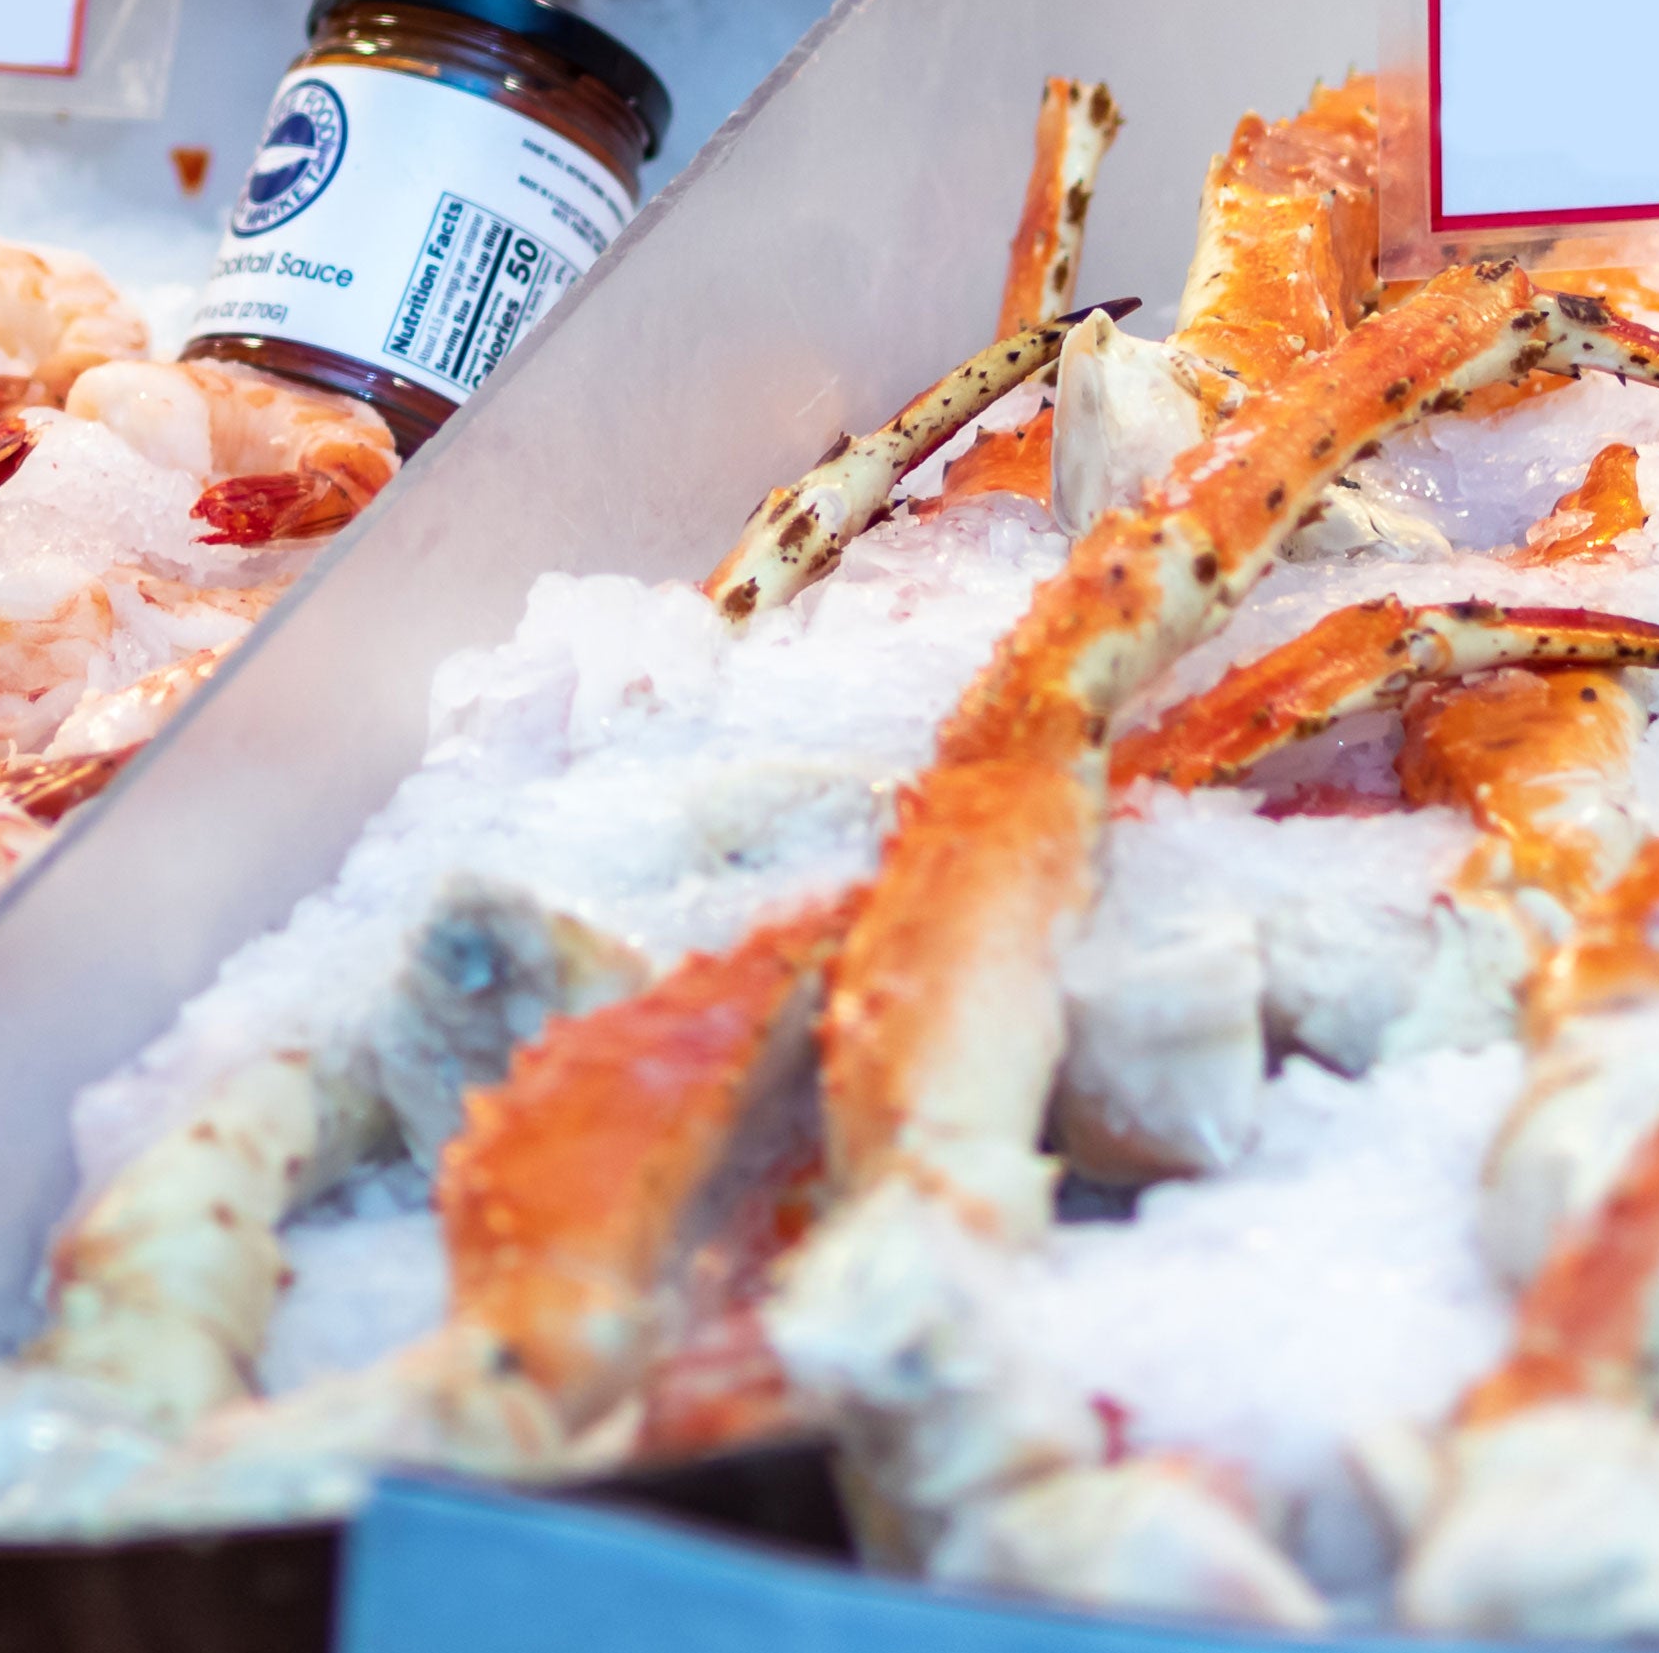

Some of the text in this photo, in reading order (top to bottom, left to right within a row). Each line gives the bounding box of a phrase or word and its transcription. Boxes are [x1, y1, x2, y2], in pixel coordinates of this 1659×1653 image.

[277, 251, 354, 288] Sauce
[390, 201, 463, 355] Nutrition Facts
[439, 275, 462, 316] servings
[454, 259, 468, 277] per
[505, 237, 539, 286] 50
[238, 301, 289, 323] (270G)
[435, 327, 464, 372] Serving
[453, 299, 472, 325] Size
[466, 274, 480, 293] 1/4
[476, 251, 491, 274] cup
